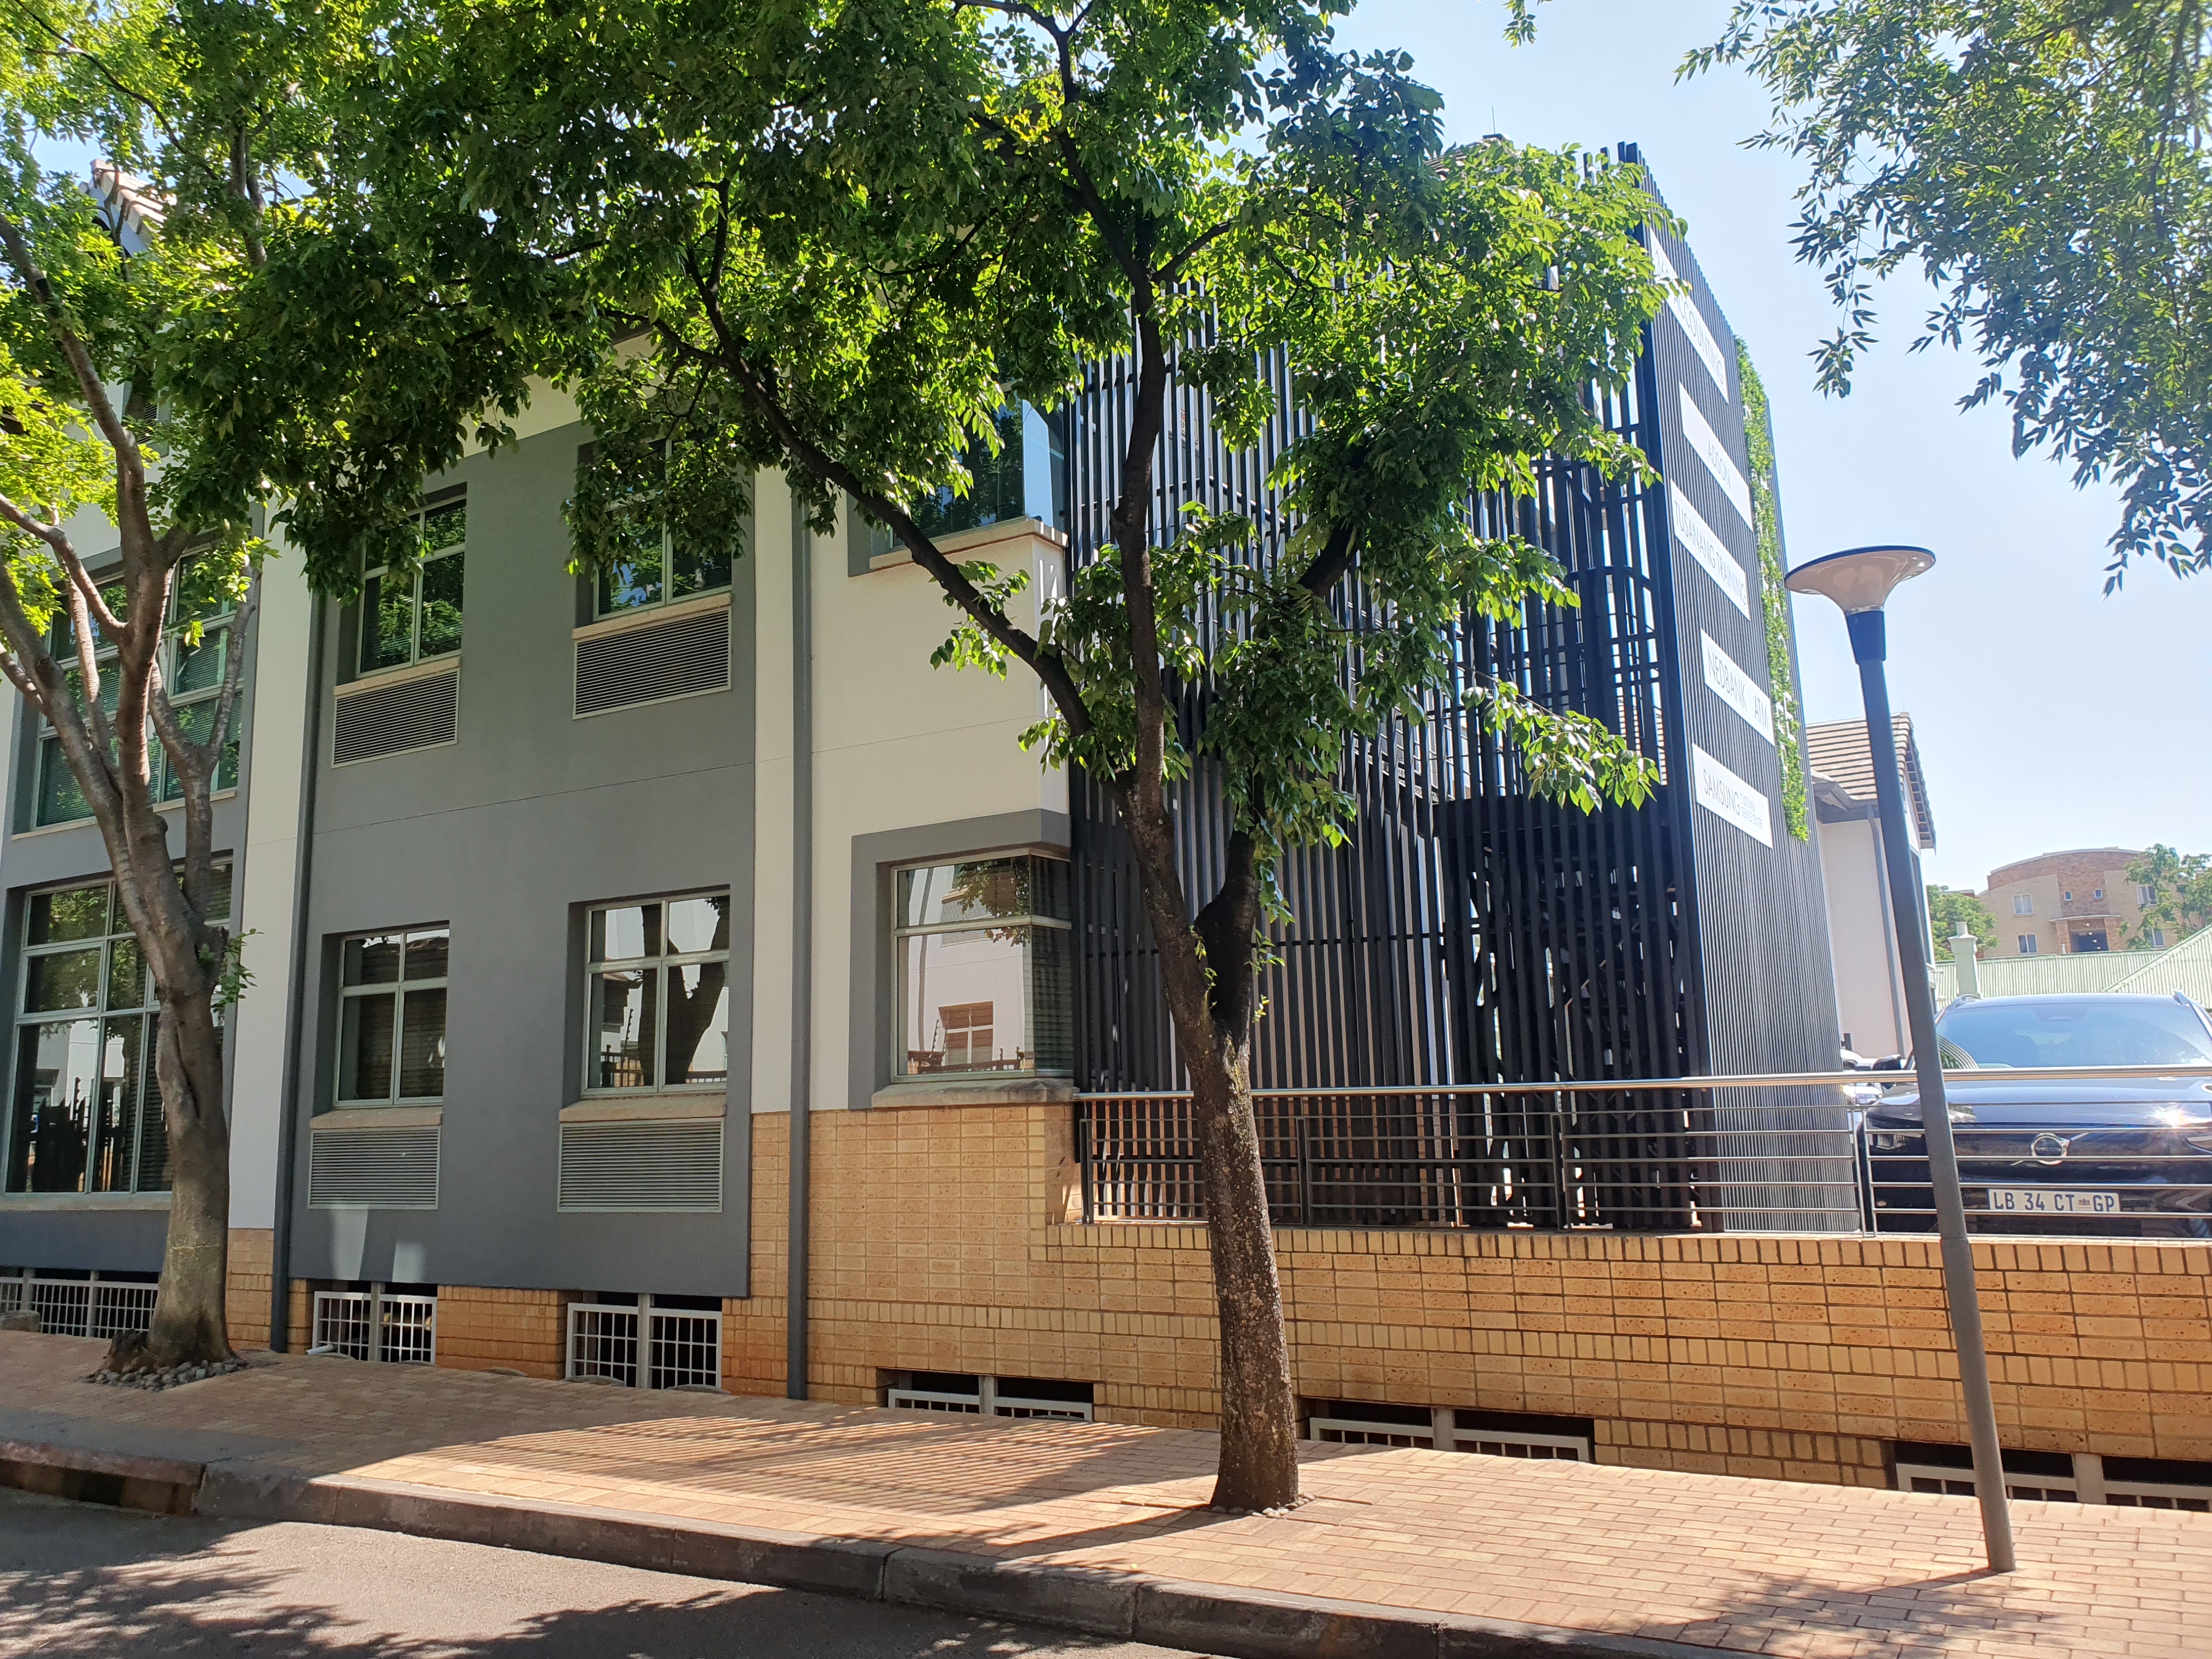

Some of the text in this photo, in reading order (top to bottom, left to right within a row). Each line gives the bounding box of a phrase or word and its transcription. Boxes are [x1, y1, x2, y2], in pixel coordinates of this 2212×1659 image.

[1708, 440, 1731, 489] ADSON
[1674, 500, 1746, 606] TUSANANG TRAINING
[1707, 647, 1769, 731] NEDBANK ATM
[1703, 768, 1740, 816] SAMSUNG
[1993, 1192, 2114, 1212] LB 34 CT GP
